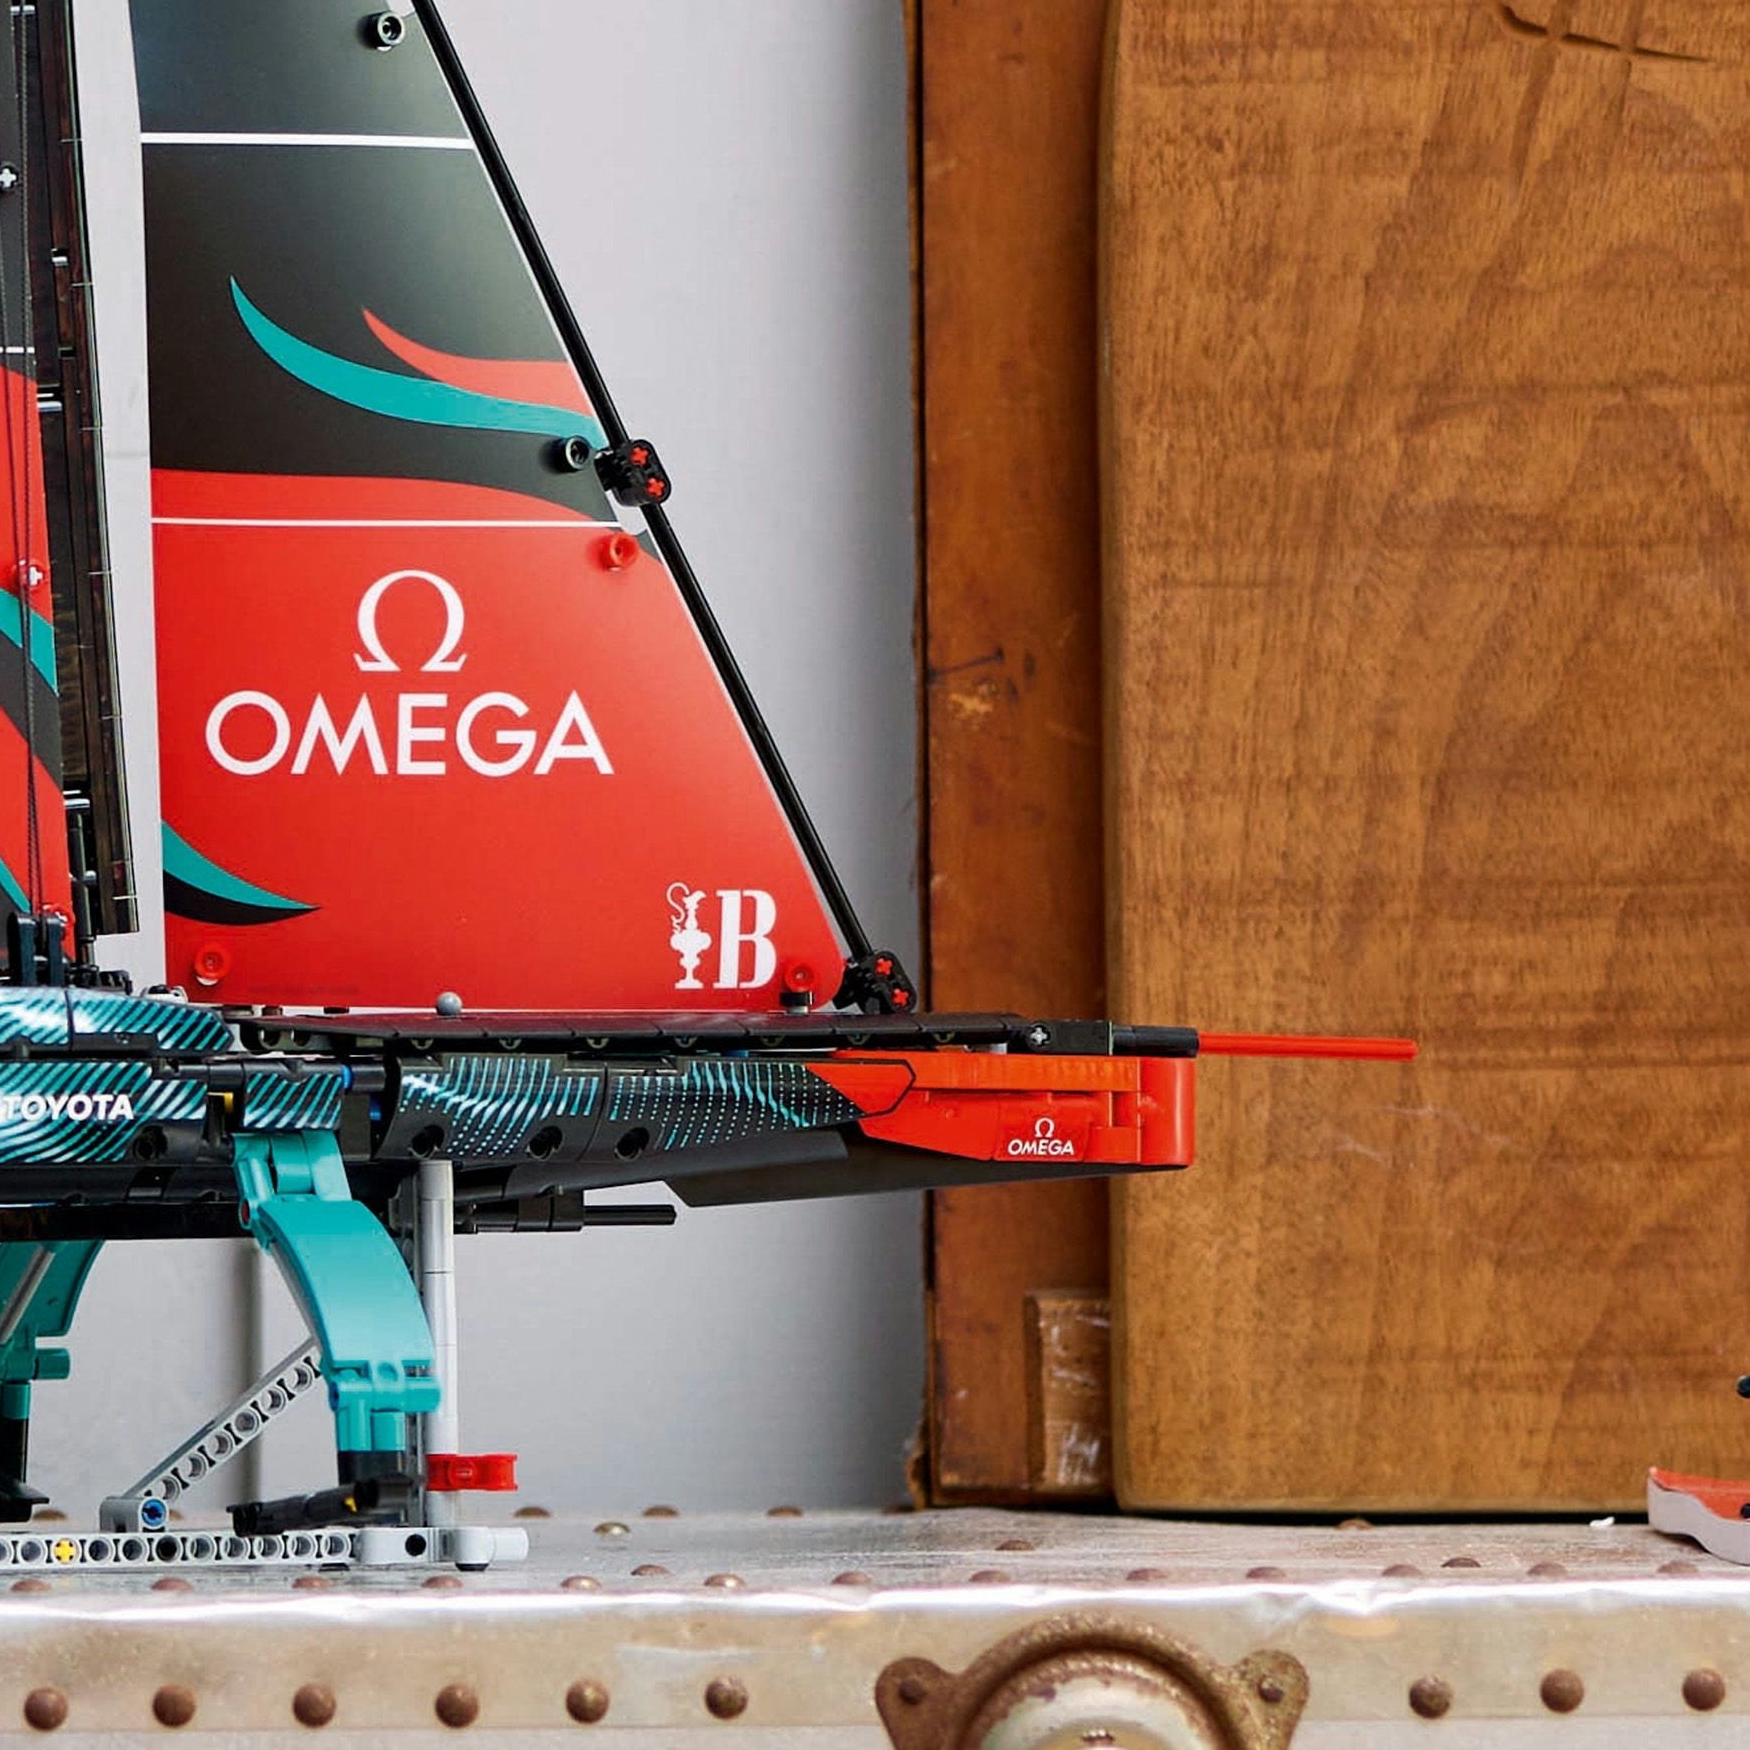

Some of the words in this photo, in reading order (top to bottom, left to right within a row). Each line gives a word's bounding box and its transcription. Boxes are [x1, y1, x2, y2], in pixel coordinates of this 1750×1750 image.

[205, 690, 614, 777] OMEGA
[3, 1094, 134, 1121] TOYOTA
[1007, 1138, 1075, 1156] OMEGA
